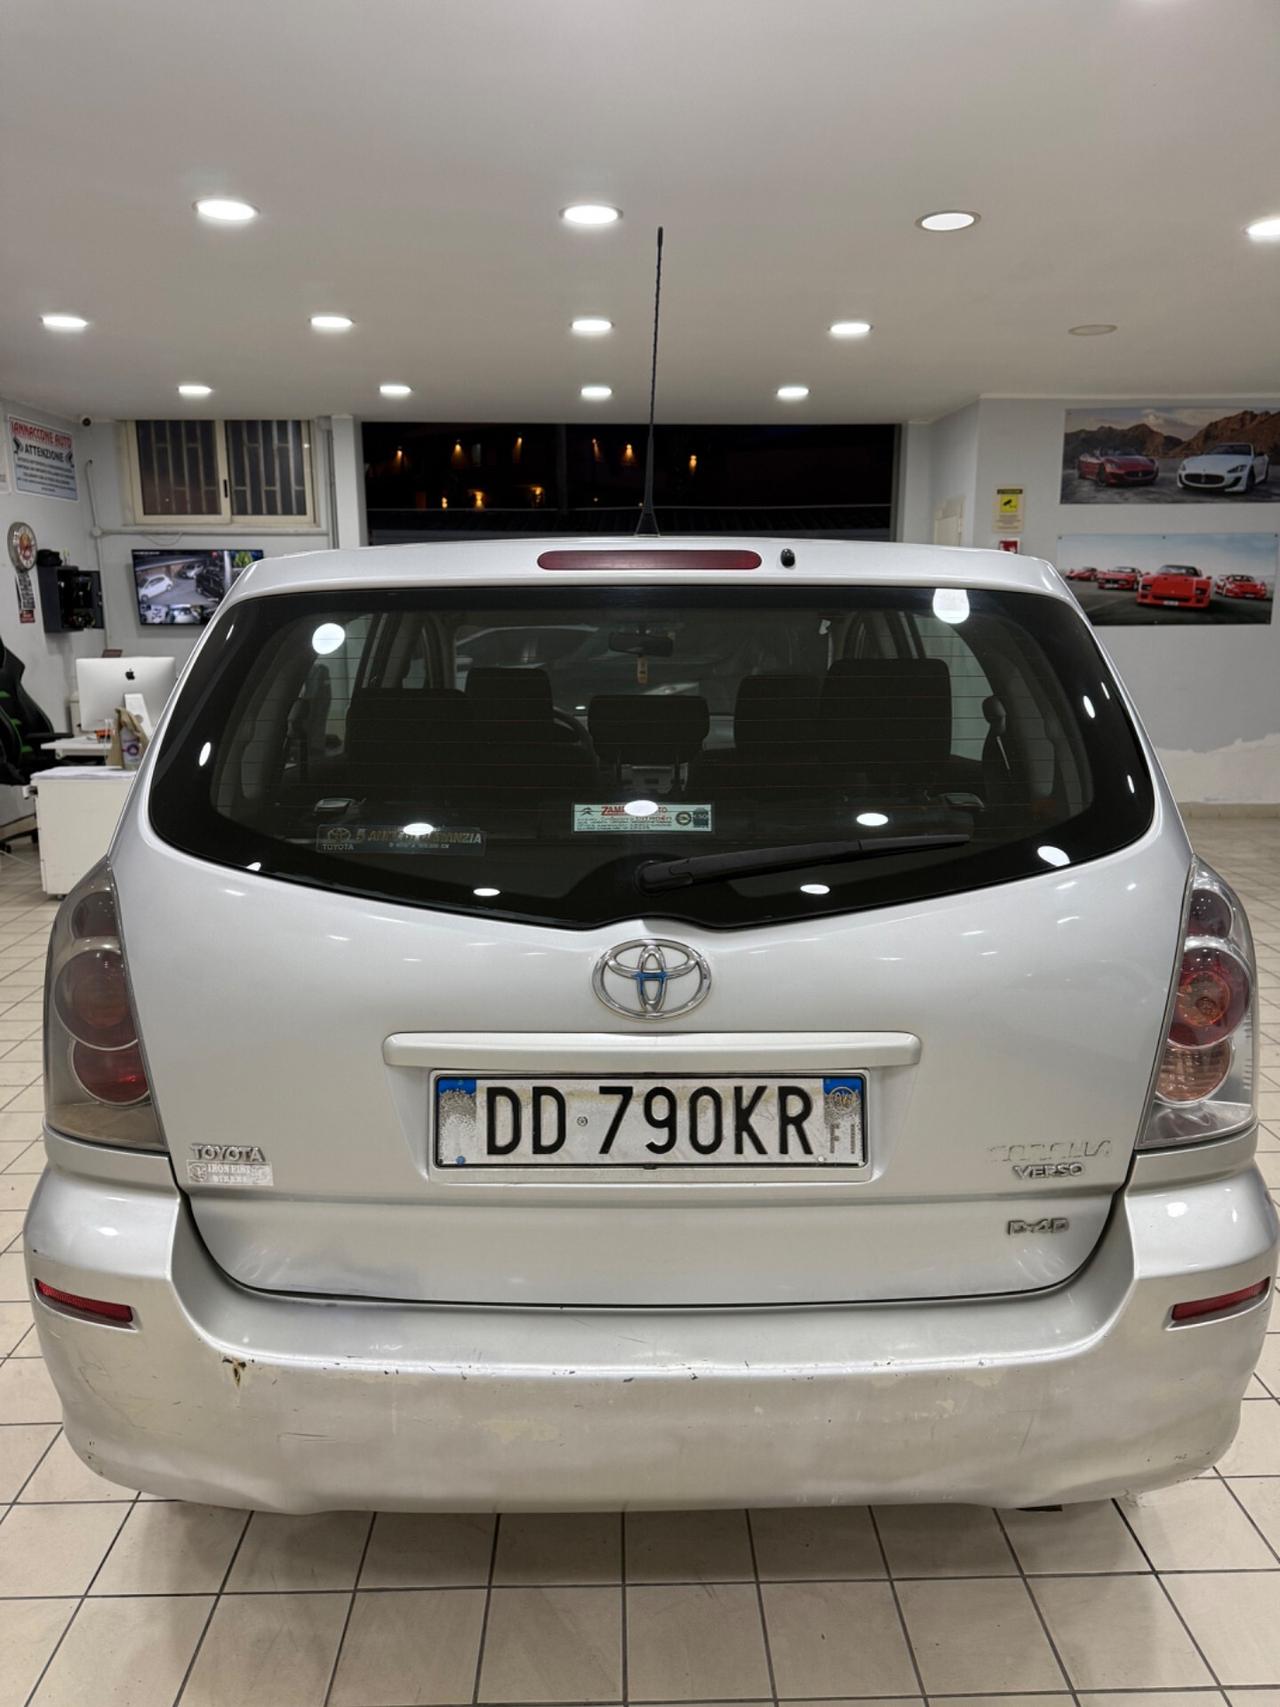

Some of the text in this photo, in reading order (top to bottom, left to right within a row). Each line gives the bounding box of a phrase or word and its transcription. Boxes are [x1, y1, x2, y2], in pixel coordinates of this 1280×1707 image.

[54, 434, 72, 449] AUTO
[24, 444, 64, 462] ATTENZIONE
[486, 1086, 567, 1156] DD
[598, 1085, 814, 1156] 790KR
[191, 1143, 266, 1162] TOYOTA
[1012, 1162, 1084, 1180] VERSO
[1007, 1218, 1070, 1236] D-4D
